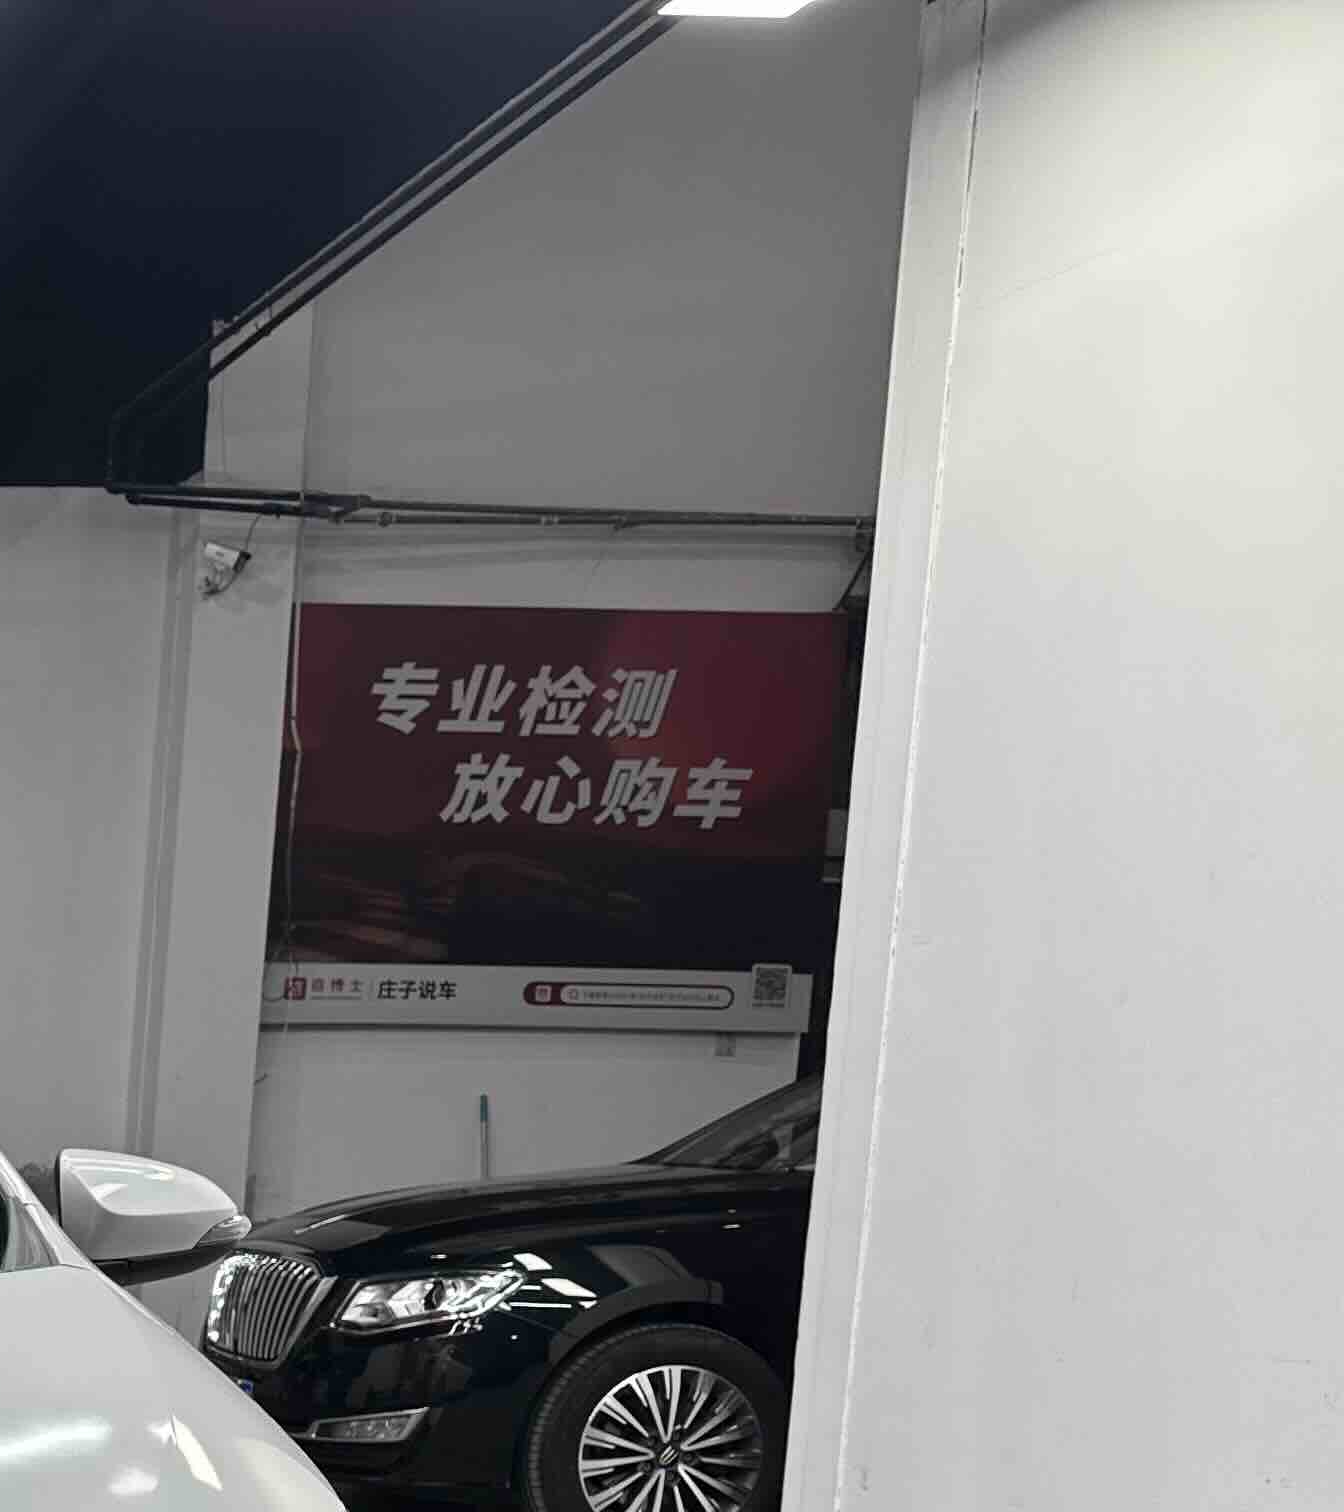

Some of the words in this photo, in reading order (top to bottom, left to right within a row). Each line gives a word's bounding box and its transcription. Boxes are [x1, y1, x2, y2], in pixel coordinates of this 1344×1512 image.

[371, 661, 678, 738] 专业检测
[439, 752, 753, 830] 放心购车
[377, 979, 456, 1000] 庄子说车
